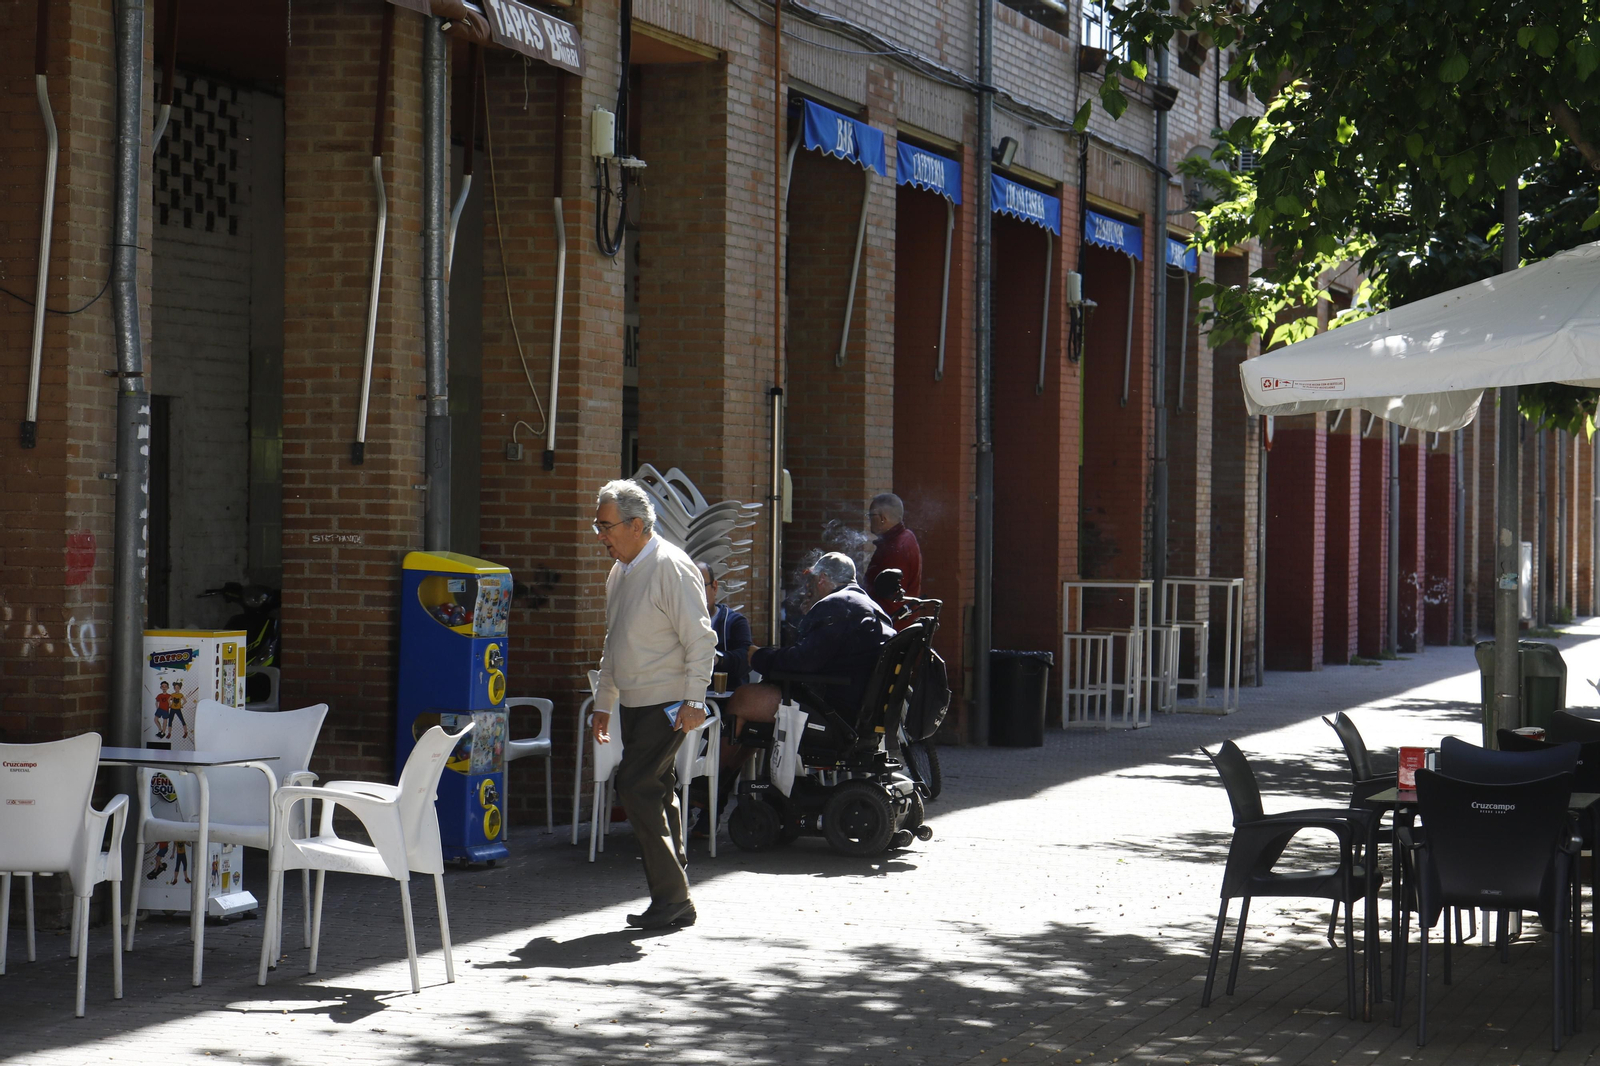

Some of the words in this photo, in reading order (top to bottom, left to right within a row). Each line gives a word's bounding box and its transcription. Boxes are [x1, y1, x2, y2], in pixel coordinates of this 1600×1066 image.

[489, 0, 544, 50] TAPAS
[543, 18, 575, 60] BAR
[835, 117, 854, 154] BAR
[913, 152, 945, 189] CAFETERIA
[154, 651, 190, 663] TATTOO
[1471, 801, 1516, 811] Cruzcampo
